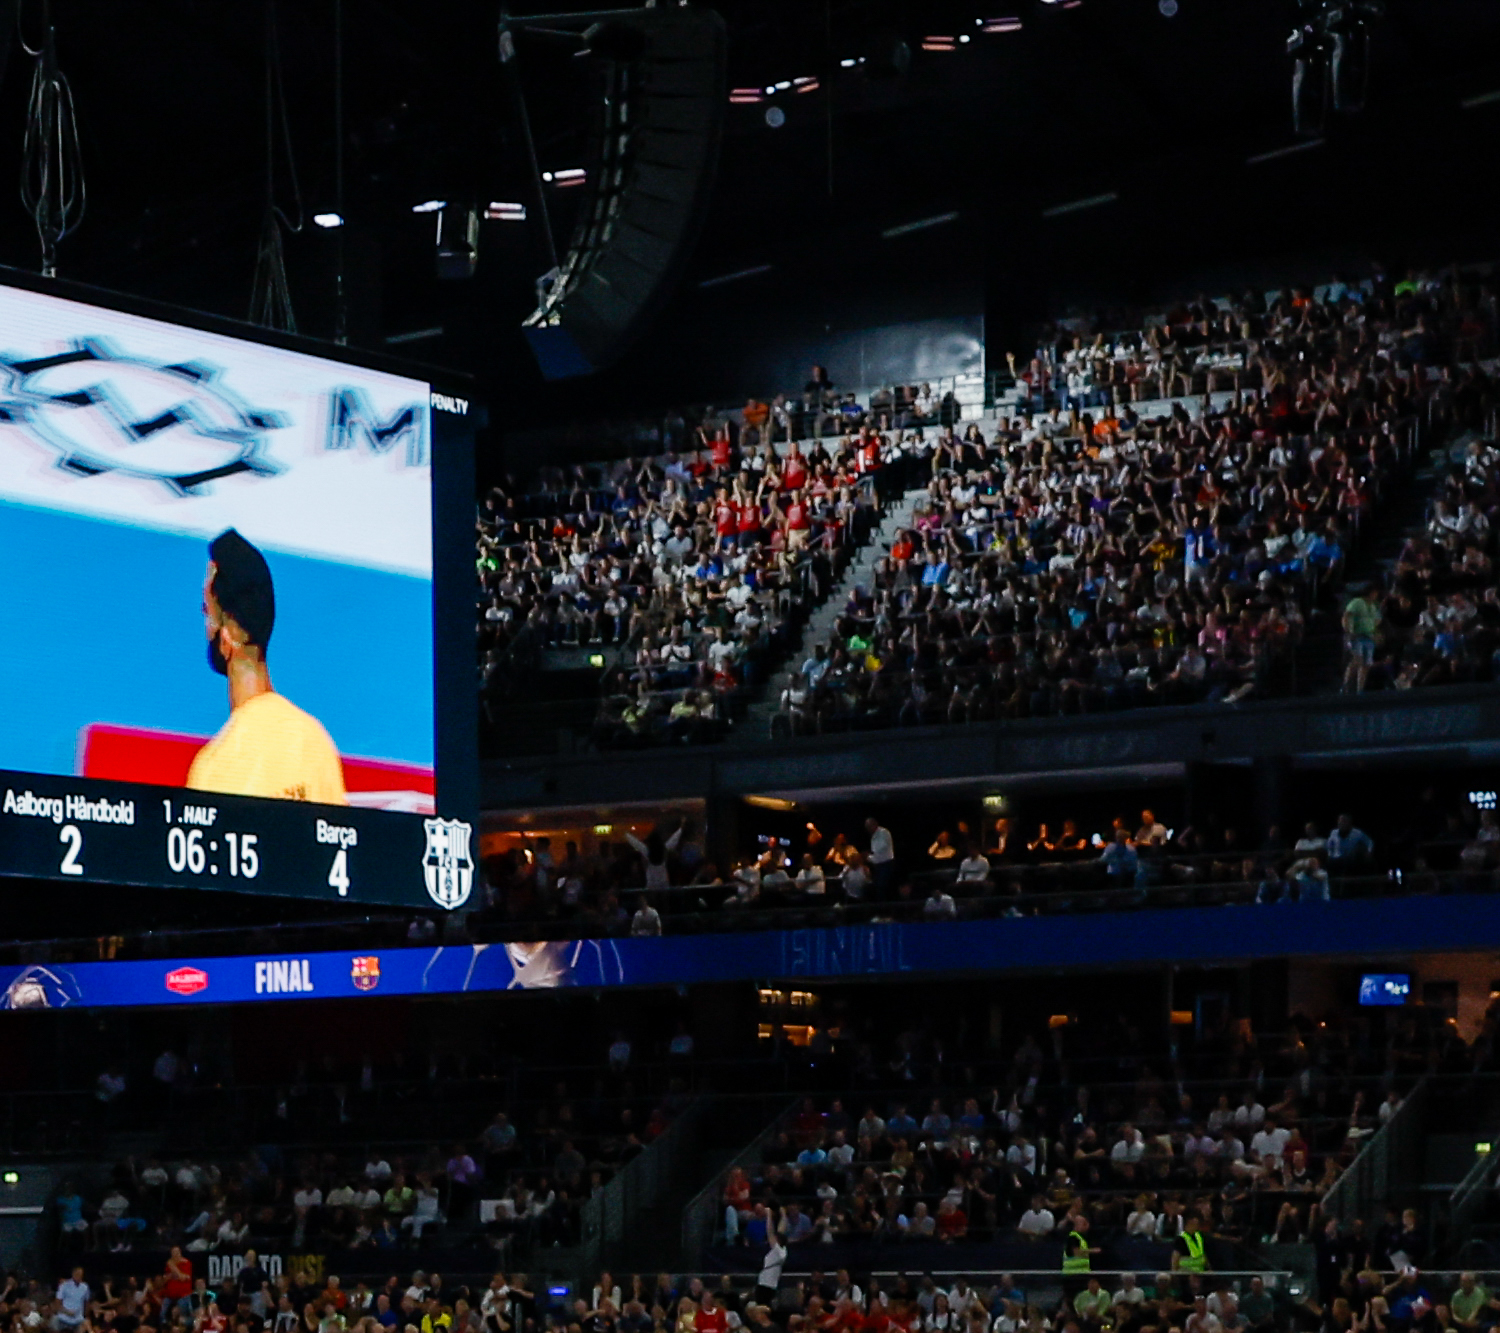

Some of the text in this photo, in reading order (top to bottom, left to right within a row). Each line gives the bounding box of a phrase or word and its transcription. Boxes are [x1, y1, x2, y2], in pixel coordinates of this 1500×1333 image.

[431, 392, 469, 416] PENALTY
[3, 789, 135, 825] Aalborg Håndbold
[60, 825, 84, 876] 2
[316, 819, 358, 849] Barça
[167, 827, 259, 879] 06:15
[328, 850, 350, 897] 4
[255, 960, 315, 994] FINAL
[208, 1254, 248, 1286] DAR
[258, 1254, 283, 1285] TO
